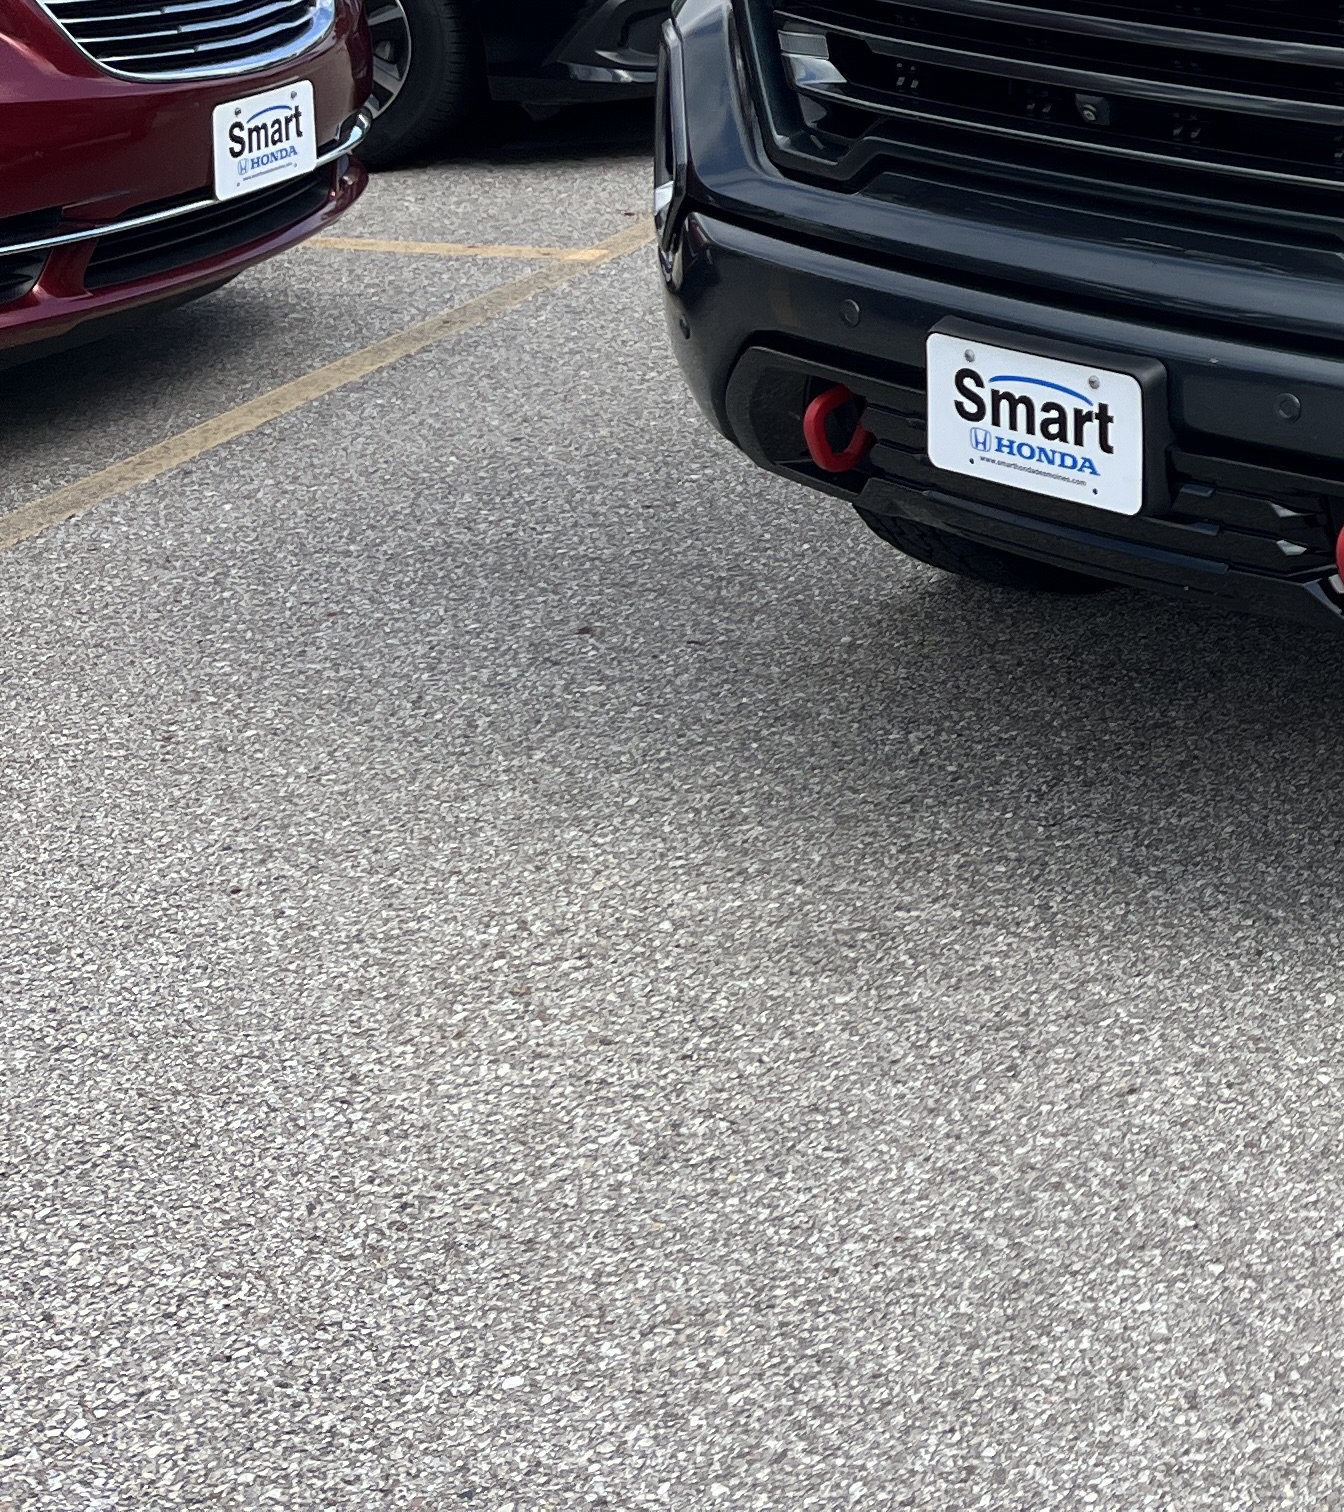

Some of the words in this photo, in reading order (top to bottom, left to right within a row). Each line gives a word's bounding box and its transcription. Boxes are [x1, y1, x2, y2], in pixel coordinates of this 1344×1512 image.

[228, 104, 303, 159] Smart
[250, 145, 298, 170] HONDA
[953, 367, 1115, 455] Smart
[994, 435, 1101, 477] HONDA
